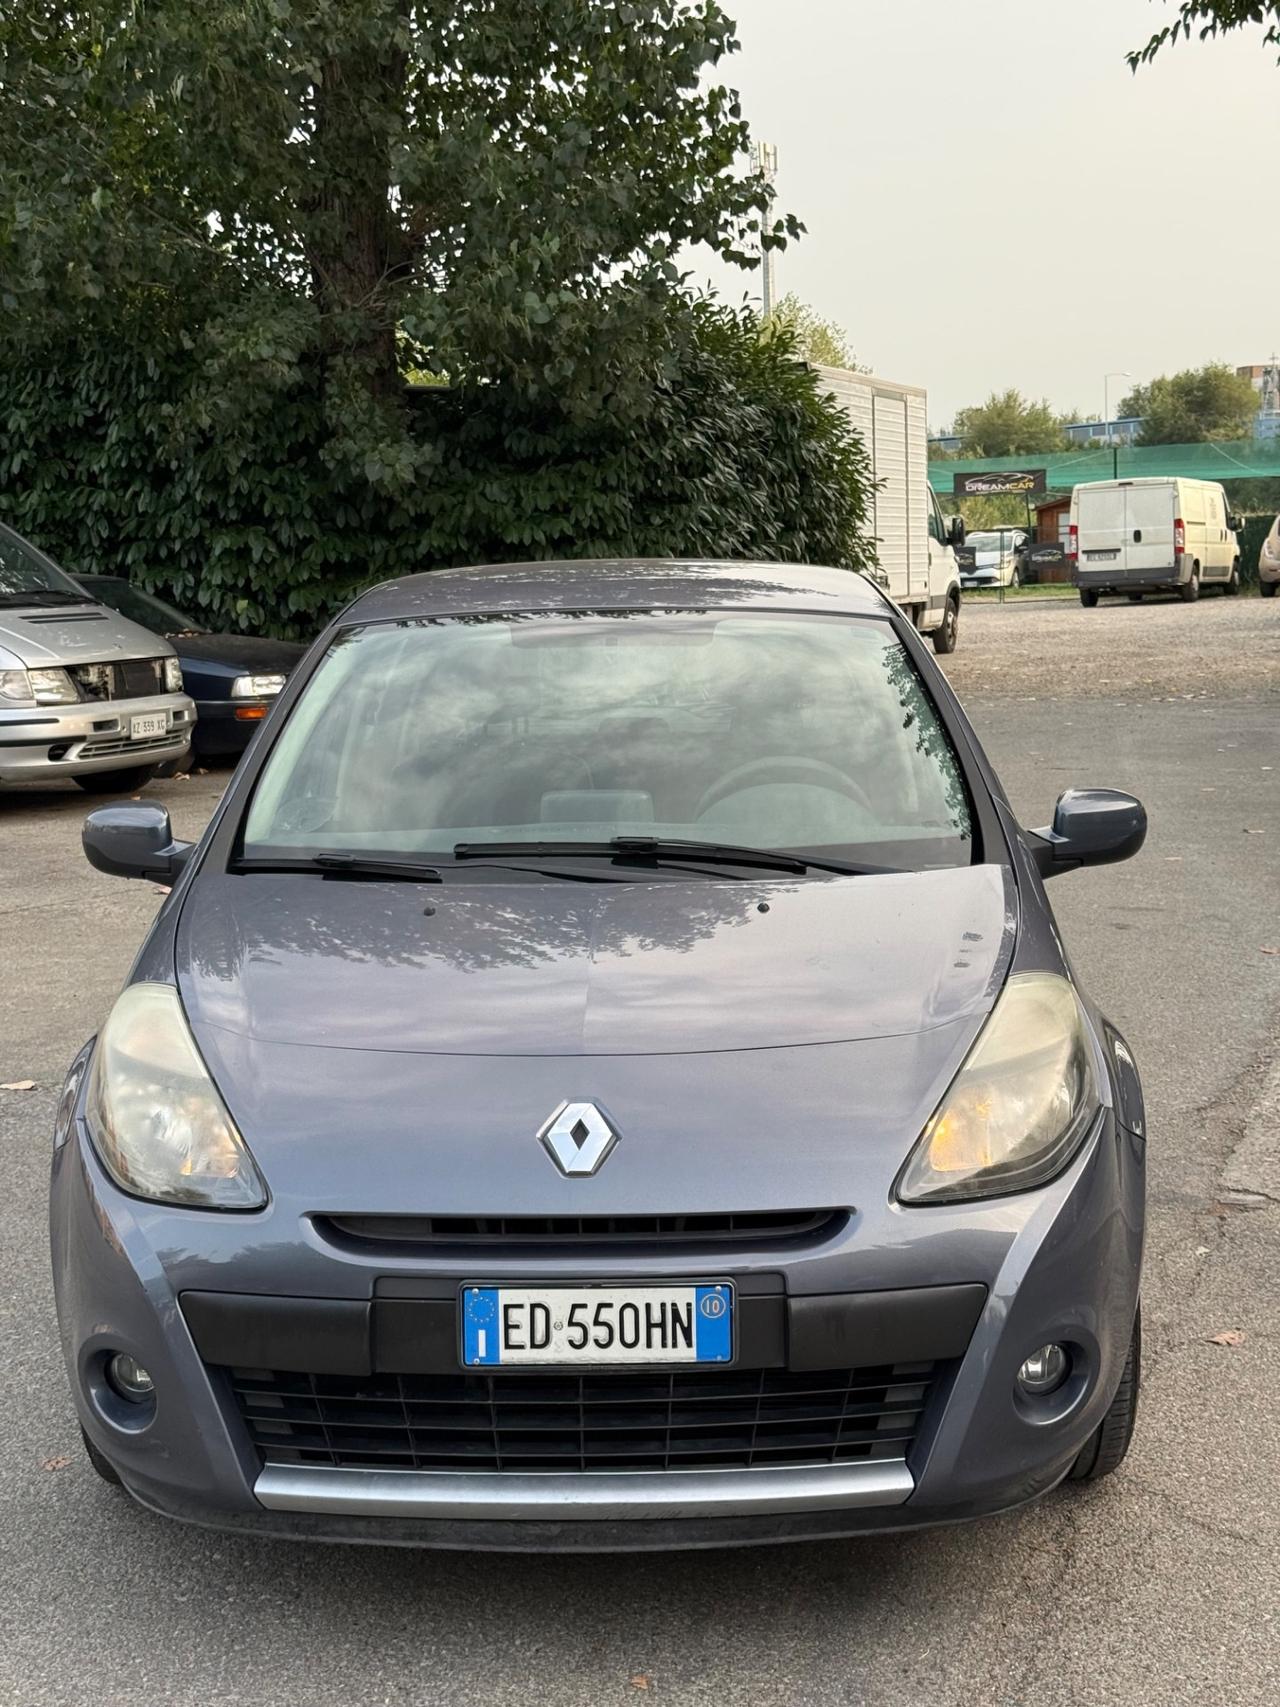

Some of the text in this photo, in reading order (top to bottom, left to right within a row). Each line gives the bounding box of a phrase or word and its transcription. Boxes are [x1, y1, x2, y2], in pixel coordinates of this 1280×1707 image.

[965, 481, 1035, 492] DREAMCAR
[503, 1302, 693, 1350] ED 550HN
